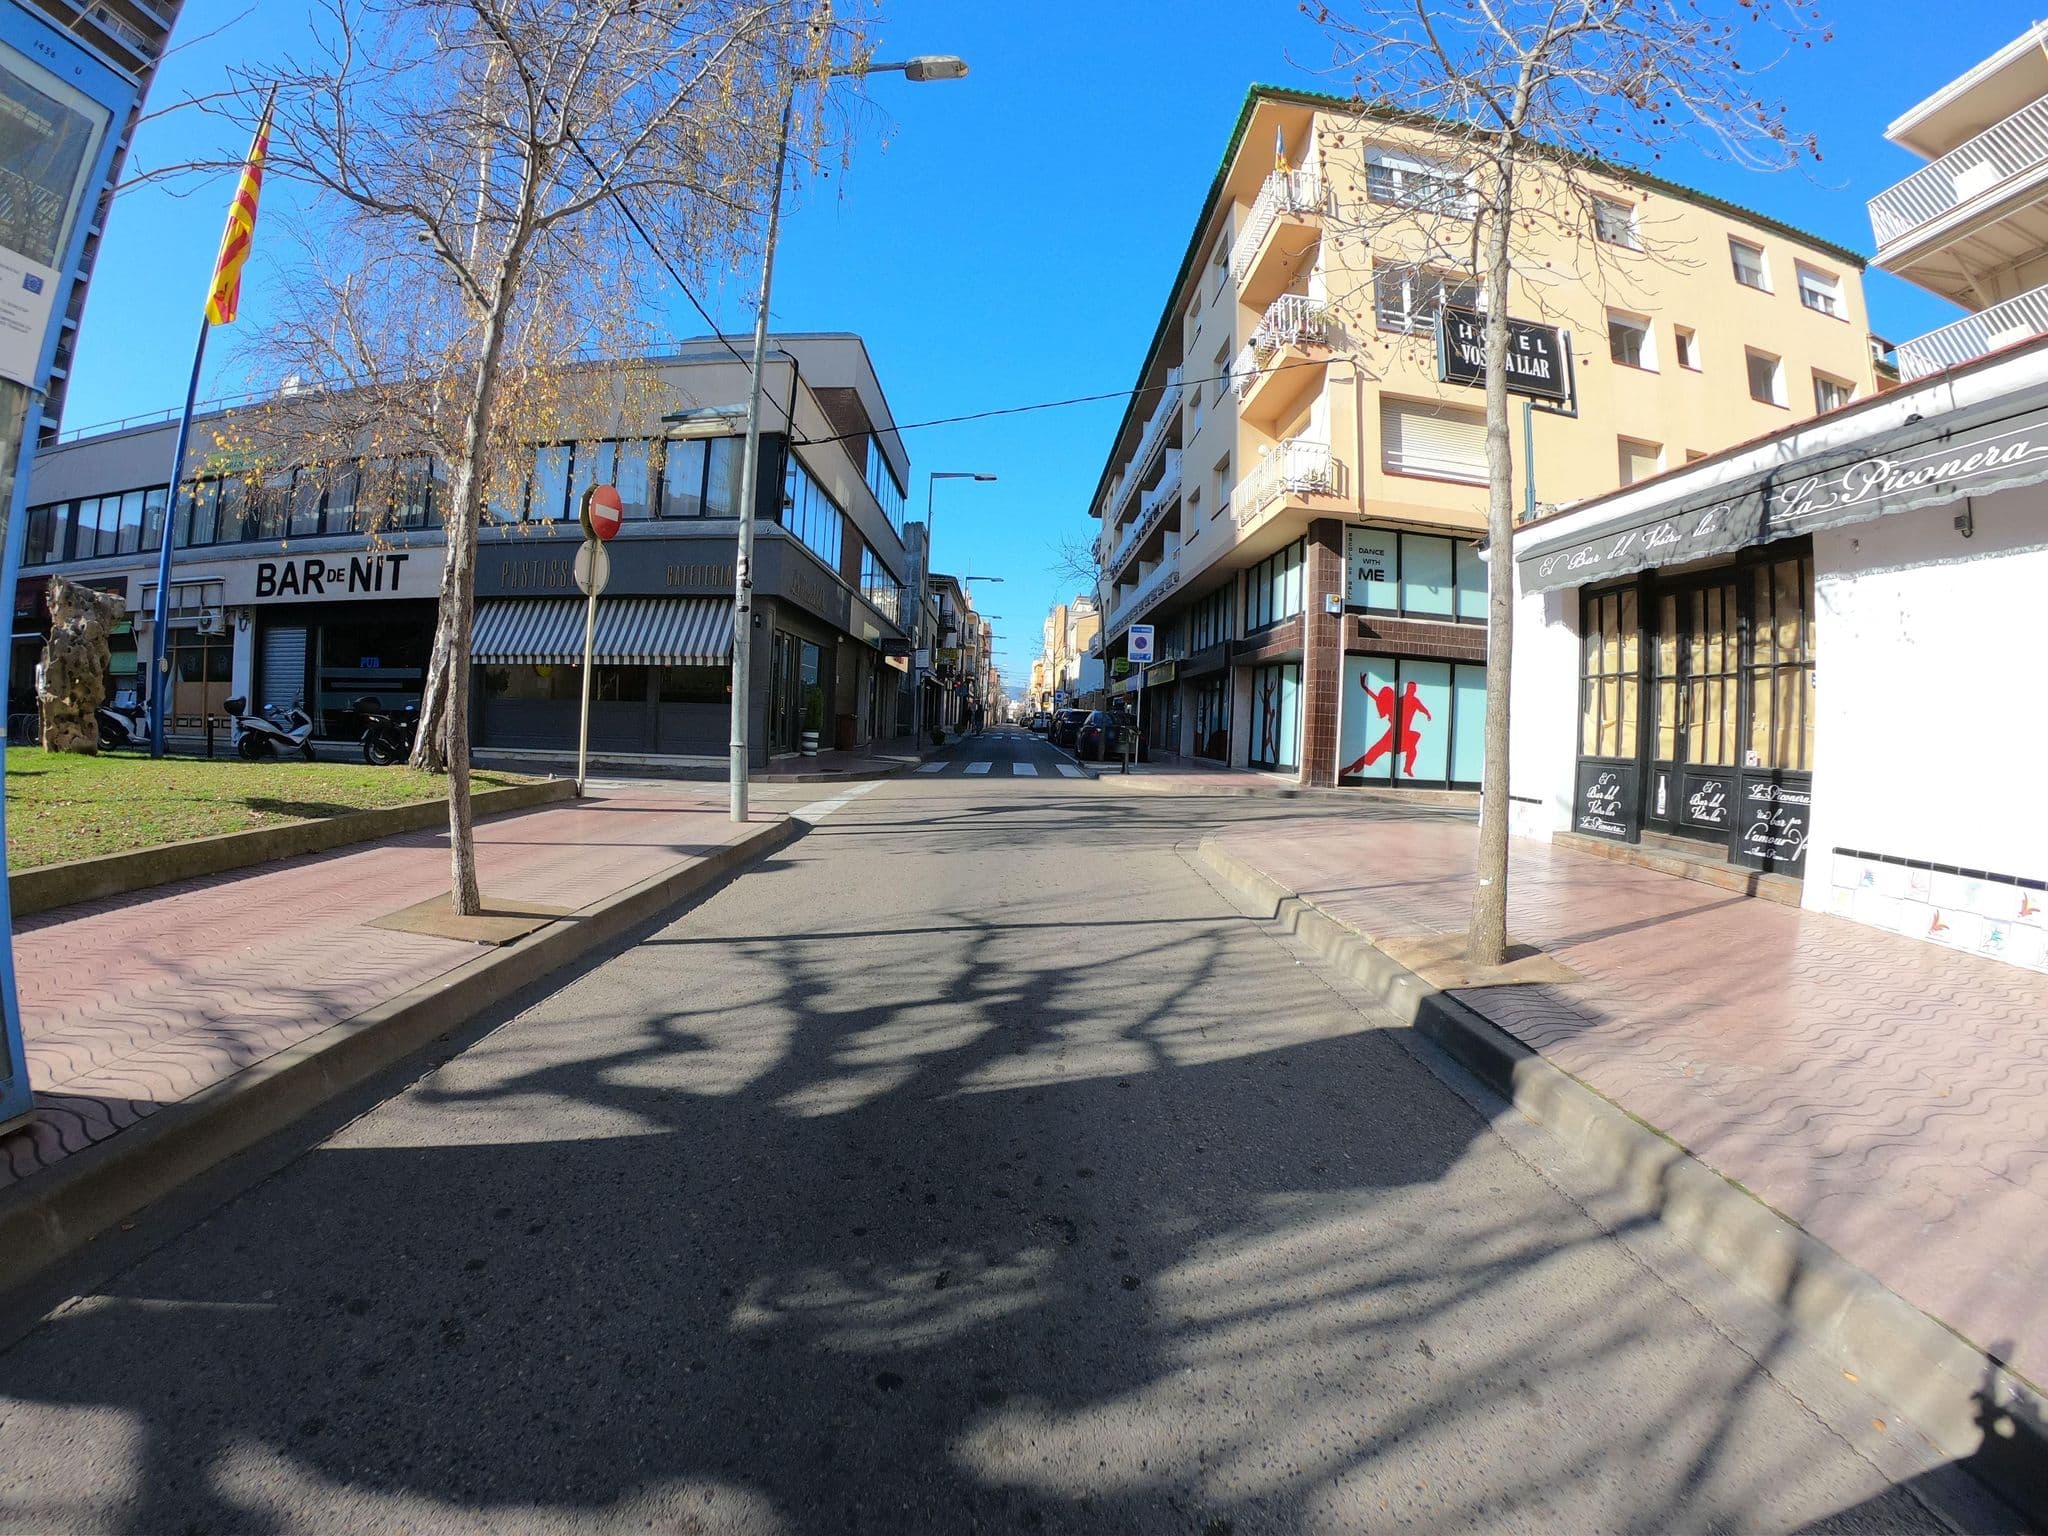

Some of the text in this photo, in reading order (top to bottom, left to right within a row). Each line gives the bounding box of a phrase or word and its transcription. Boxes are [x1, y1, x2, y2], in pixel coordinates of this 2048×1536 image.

[1460, 344, 1551, 378] VOSA LLAR
[1771, 440, 2048, 520] La Piconera
[1358, 547, 1384, 556] DANCE
[1539, 506, 1731, 577] El Bar del Vostra llar
[1362, 558, 1381, 566] WITH
[256, 554, 409, 597] BAR DE NIT
[666, 565, 733, 587] CAFETERIA
[1358, 567, 1384, 581] ME
[360, 655, 380, 668] PUB
[1770, 808, 1786, 827] bar
